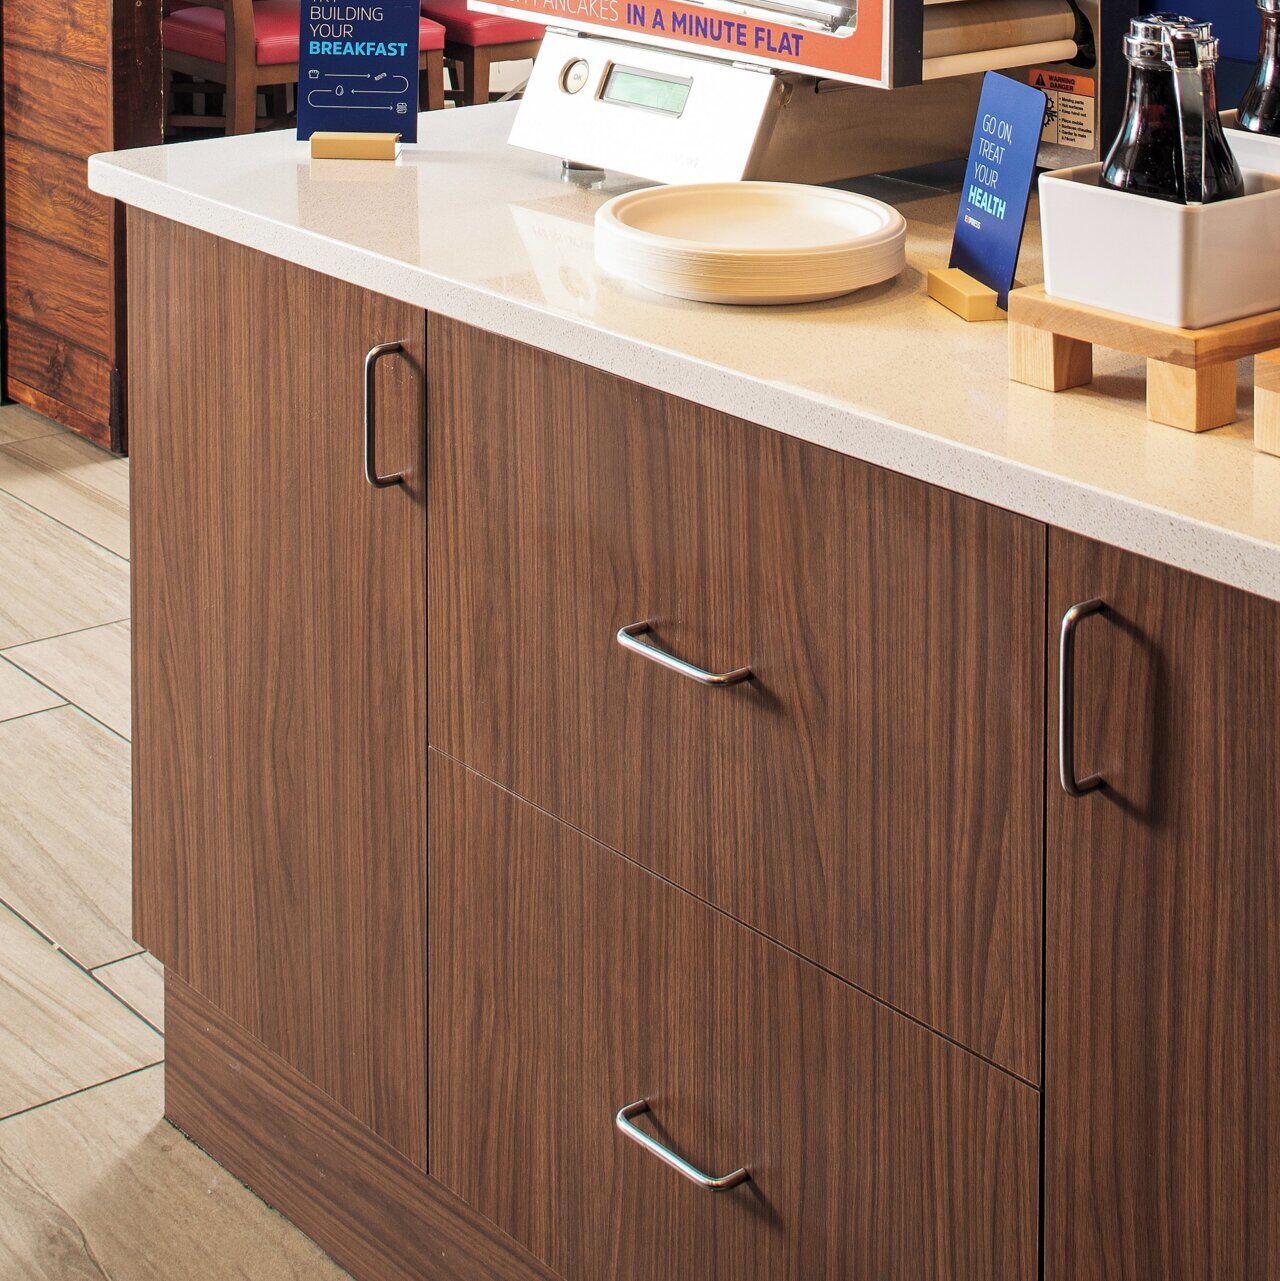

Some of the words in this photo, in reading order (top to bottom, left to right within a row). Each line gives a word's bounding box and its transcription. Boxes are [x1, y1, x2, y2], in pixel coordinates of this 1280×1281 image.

[310, 6, 384, 21] BUILDING
[309, 23, 354, 38] YOUR
[626, 3, 646, 27] IN
[651, 8, 665, 31] A
[671, 11, 747, 47] MINUTE
[754, 26, 804, 57] FLAT
[309, 41, 408, 57] BREAKFAST
[1049, 75, 1075, 85] WARNING
[1050, 83, 1074, 92] DANGER
[982, 113, 998, 135] GO
[997, 122, 1013, 144] ON,
[978, 137, 1006, 164] TREAT
[974, 161, 999, 190] YOUR
[968, 184, 1007, 220] HEALTH
